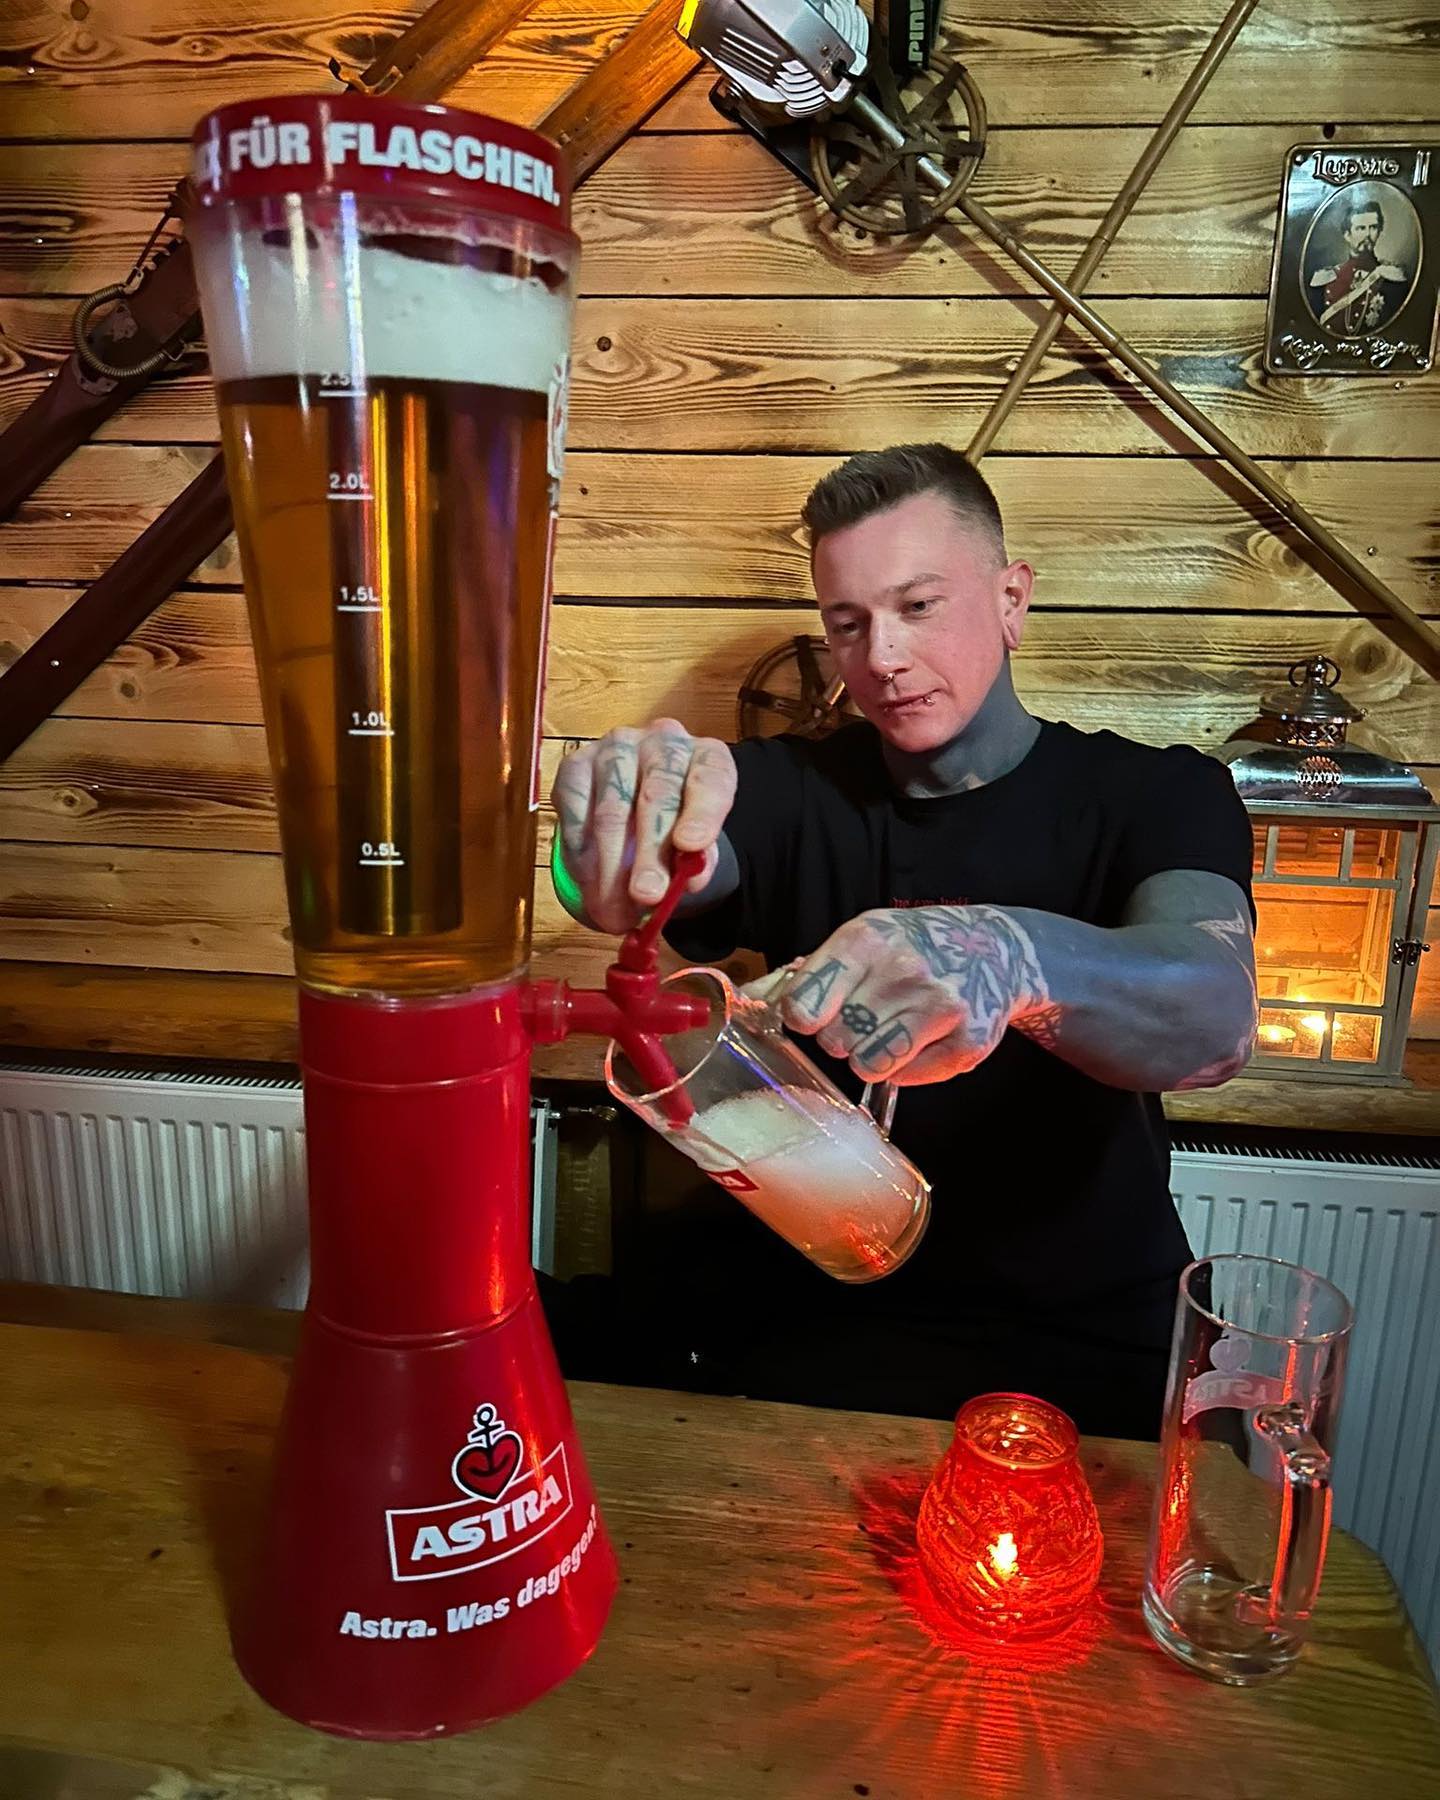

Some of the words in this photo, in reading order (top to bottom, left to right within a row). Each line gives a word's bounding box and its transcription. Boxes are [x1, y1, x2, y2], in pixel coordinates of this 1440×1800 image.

[228, 116, 311, 171] FÜR
[327, 121, 560, 207] FLASCHEN.
[329, 472, 369, 490] 2.0L
[340, 586, 380, 602] 1.5L
[352, 711, 391, 727] 1.0L
[361, 842, 401, 857] 0.5L
[411, 1474, 563, 1561] ASTRA
[340, 1611, 437, 1640] Astra.
[446, 1597, 510, 1633] Was
